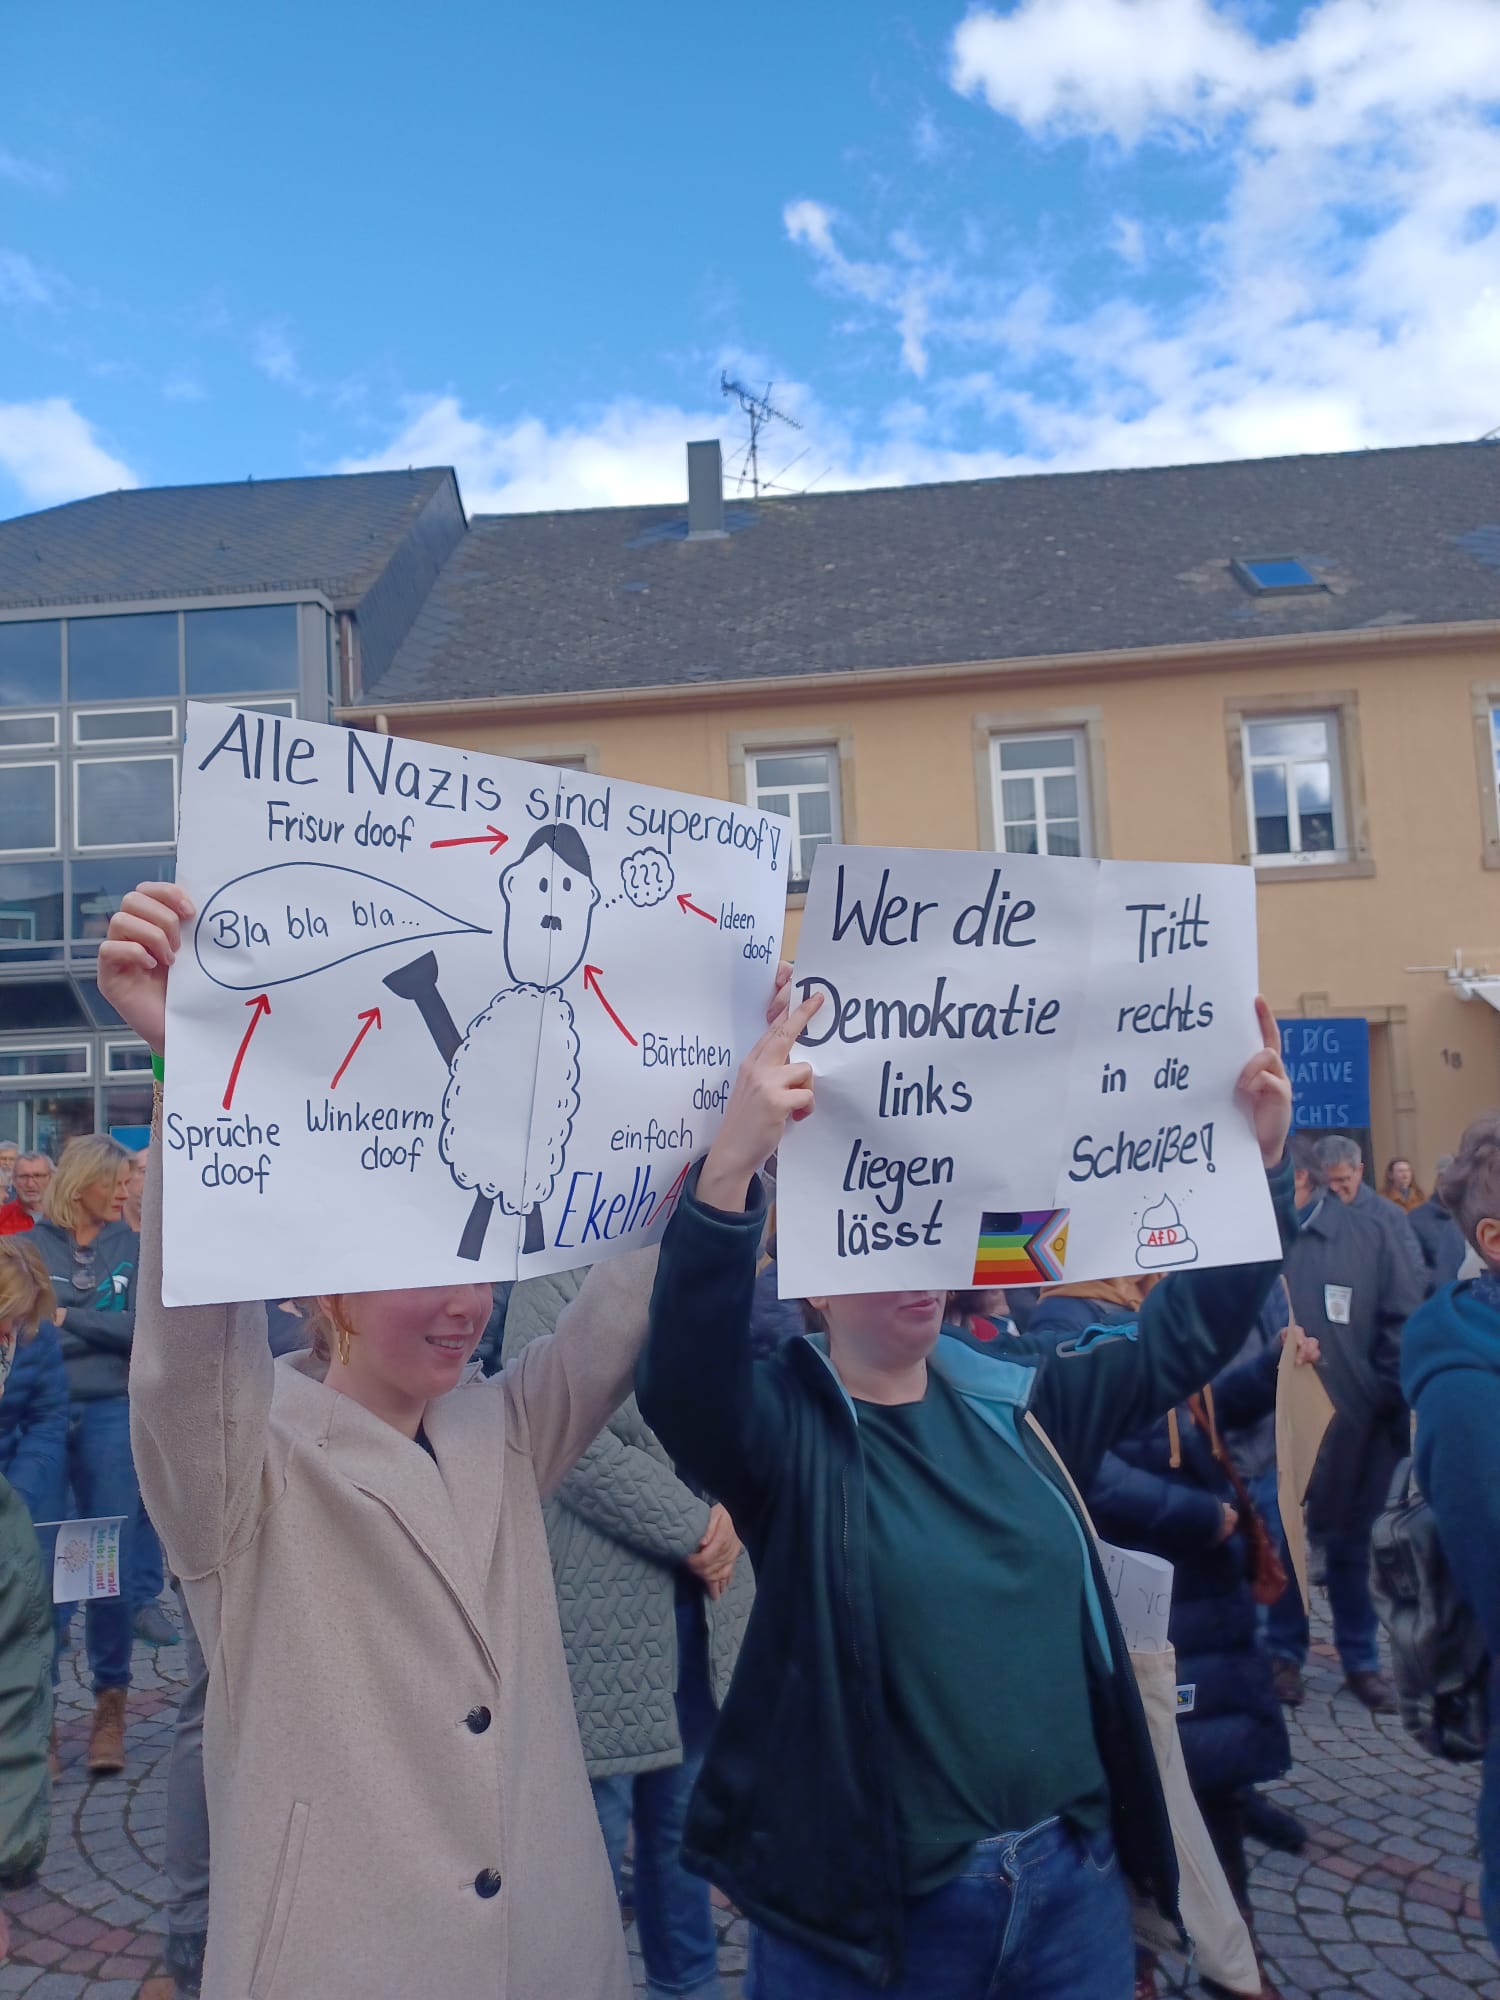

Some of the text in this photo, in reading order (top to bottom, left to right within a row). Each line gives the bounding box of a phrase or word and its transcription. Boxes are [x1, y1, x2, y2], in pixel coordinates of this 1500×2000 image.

[198, 713, 781, 871] Alle Nazis sind superdoof!
[267, 801, 414, 852] Frisur doof
[208, 910, 270, 949] Bla
[287, 905, 328, 939] bla
[720, 902, 754, 930] Ideen
[832, 865, 1036, 947] Wer die
[743, 935, 774, 964] doof
[1126, 894, 1209, 963] Tritt
[795, 977, 1060, 1047] Demokratie
[1117, 985, 1213, 1033] rechts
[693, 1079, 729, 1114] doof
[879, 1061, 972, 1117] links
[1101, 1058, 1189, 1094] in die
[306, 1098, 434, 1132] Winkearm
[610, 1118, 693, 1153] einfach
[202, 1152, 271, 1194] doof
[361, 1136, 424, 1172] doof
[842, 1139, 954, 1214] liegen
[837, 1199, 943, 1257] lässt
[1147, 1229, 1177, 1246] AfD
